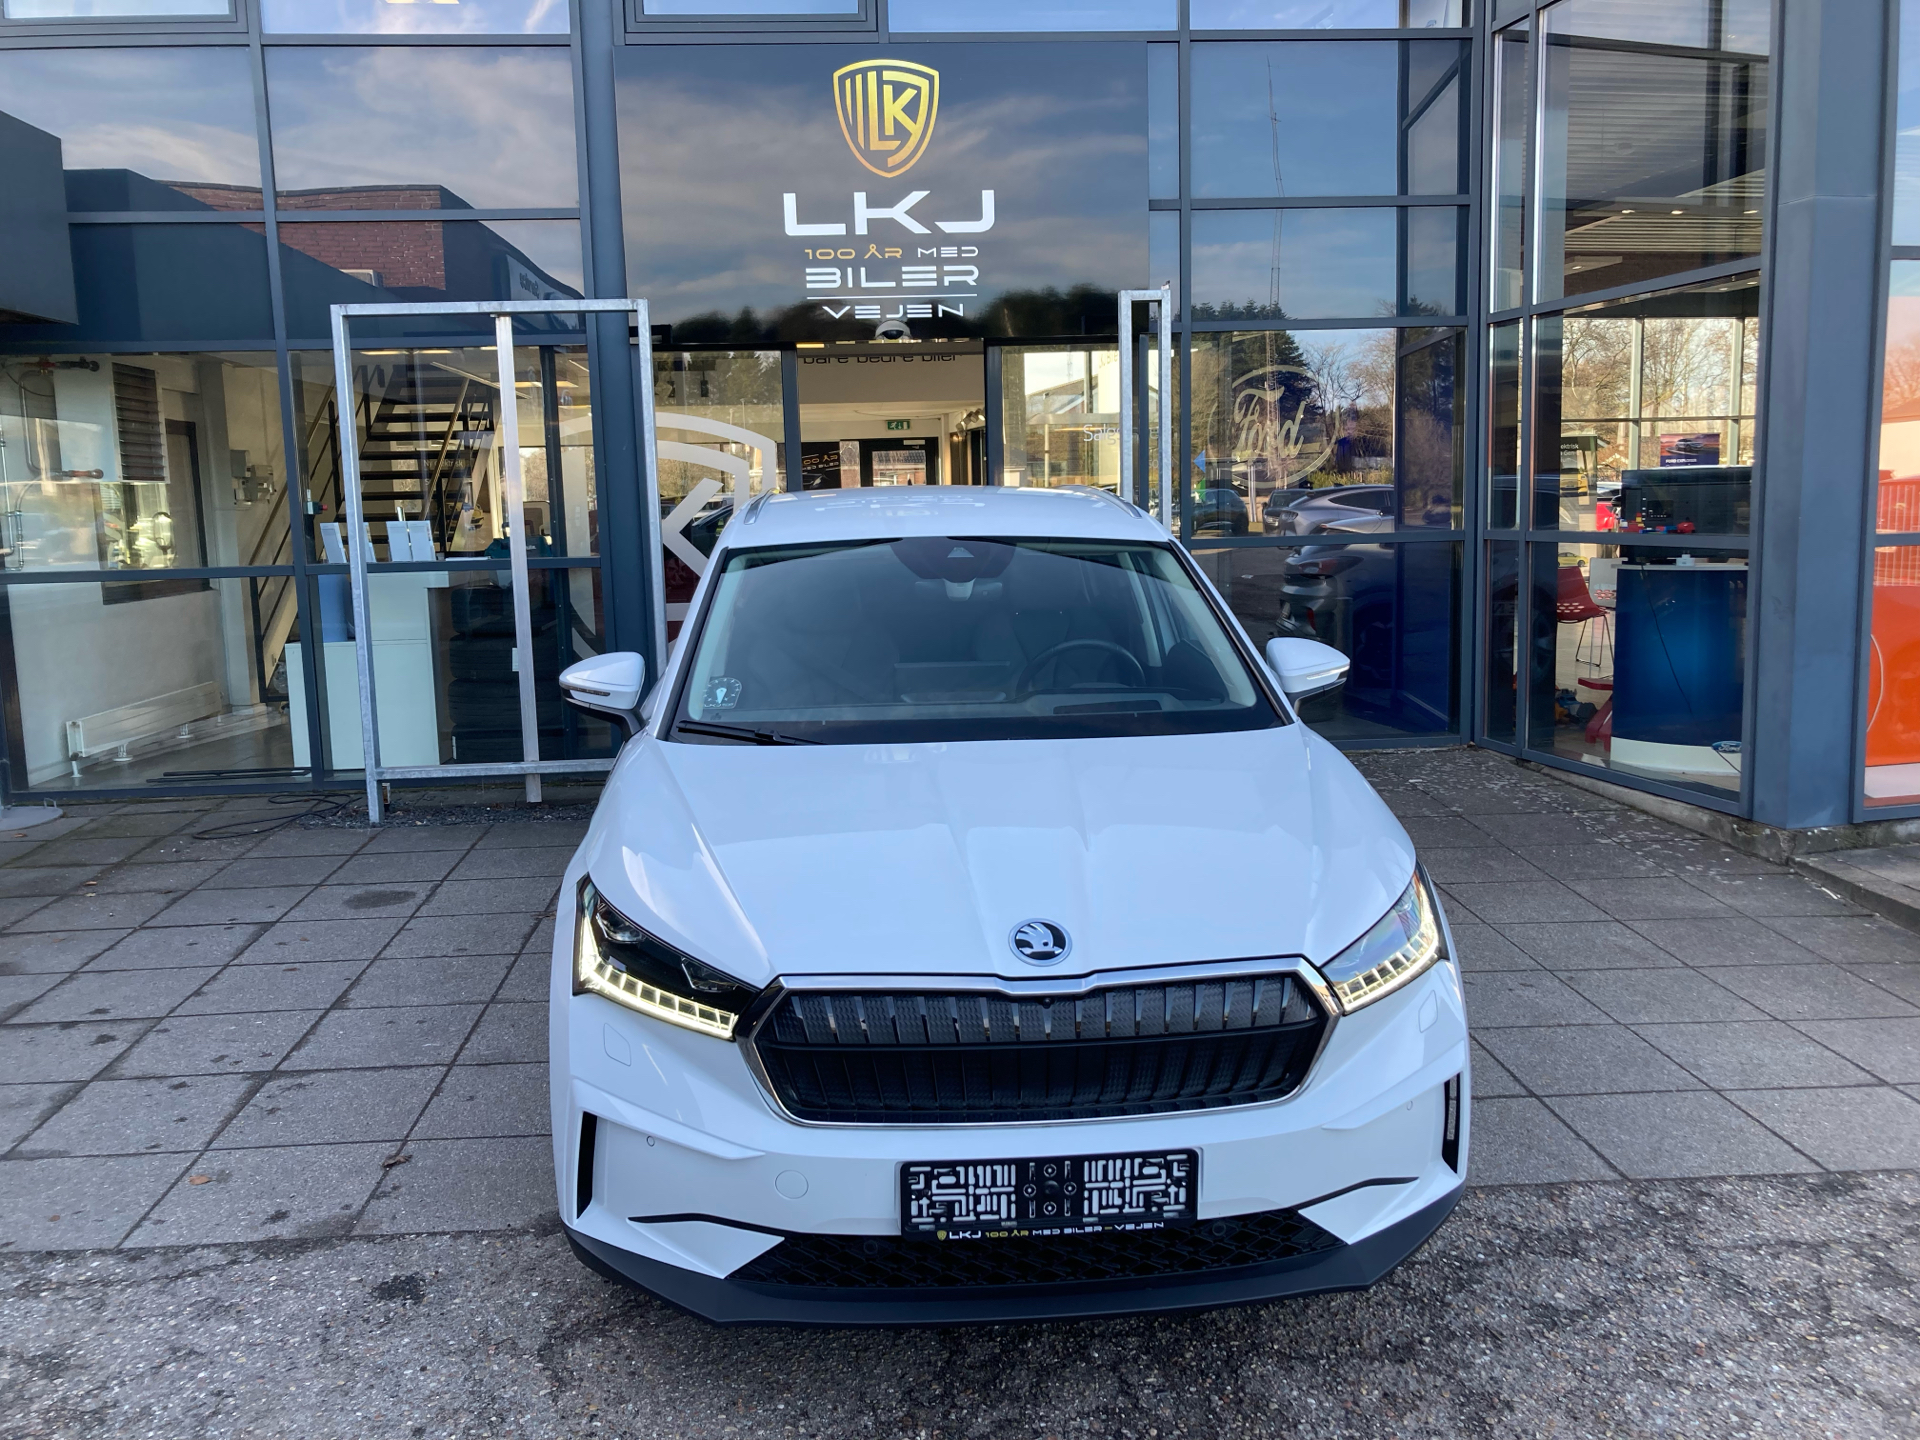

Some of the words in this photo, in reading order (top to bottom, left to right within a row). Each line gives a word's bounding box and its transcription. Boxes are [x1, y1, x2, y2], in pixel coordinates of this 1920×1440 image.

[783, 189, 995, 236] LKJ
[804, 248, 856, 260] 100
[864, 243, 903, 259] ÅR
[917, 246, 979, 258] MED
[805, 265, 980, 289] BILER
[822, 303, 964, 319] VEJEN
[949, 1231, 981, 1239] LKJ
[1063, 1225, 1102, 1234] BILER
[1114, 1221, 1164, 1231] VEJEN
